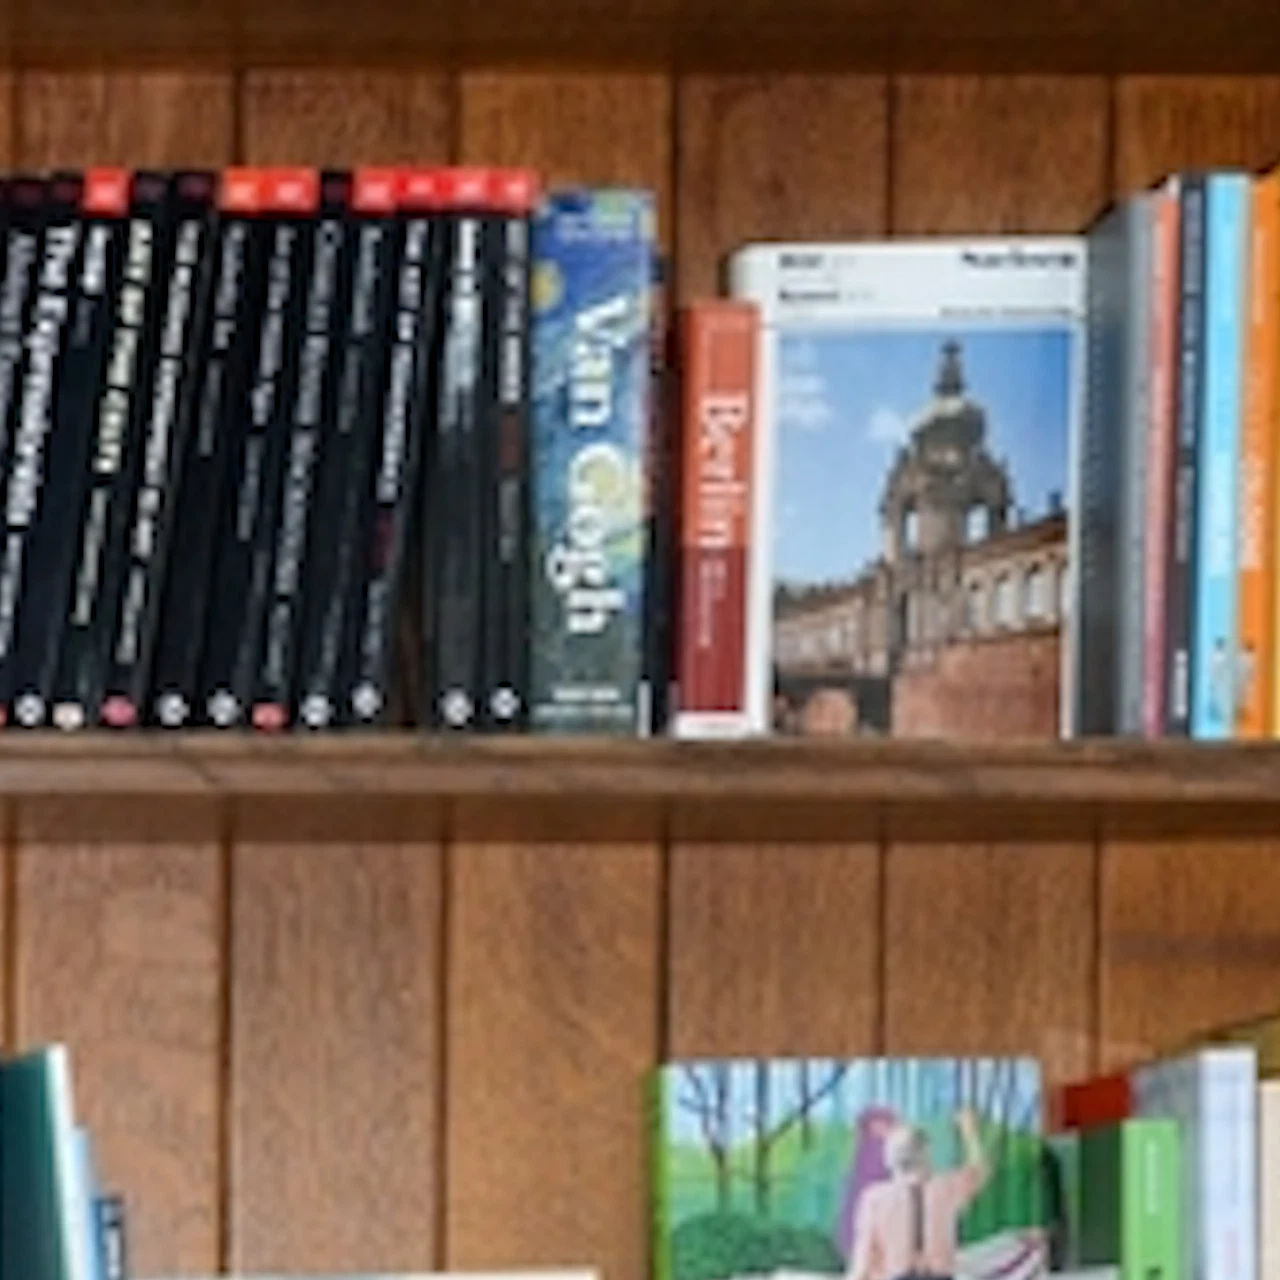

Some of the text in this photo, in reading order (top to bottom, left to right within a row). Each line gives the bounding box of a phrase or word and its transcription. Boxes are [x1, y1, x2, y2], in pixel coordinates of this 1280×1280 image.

[545, 296, 628, 635] Van Gogh
[698, 390, 750, 550] Berlin
